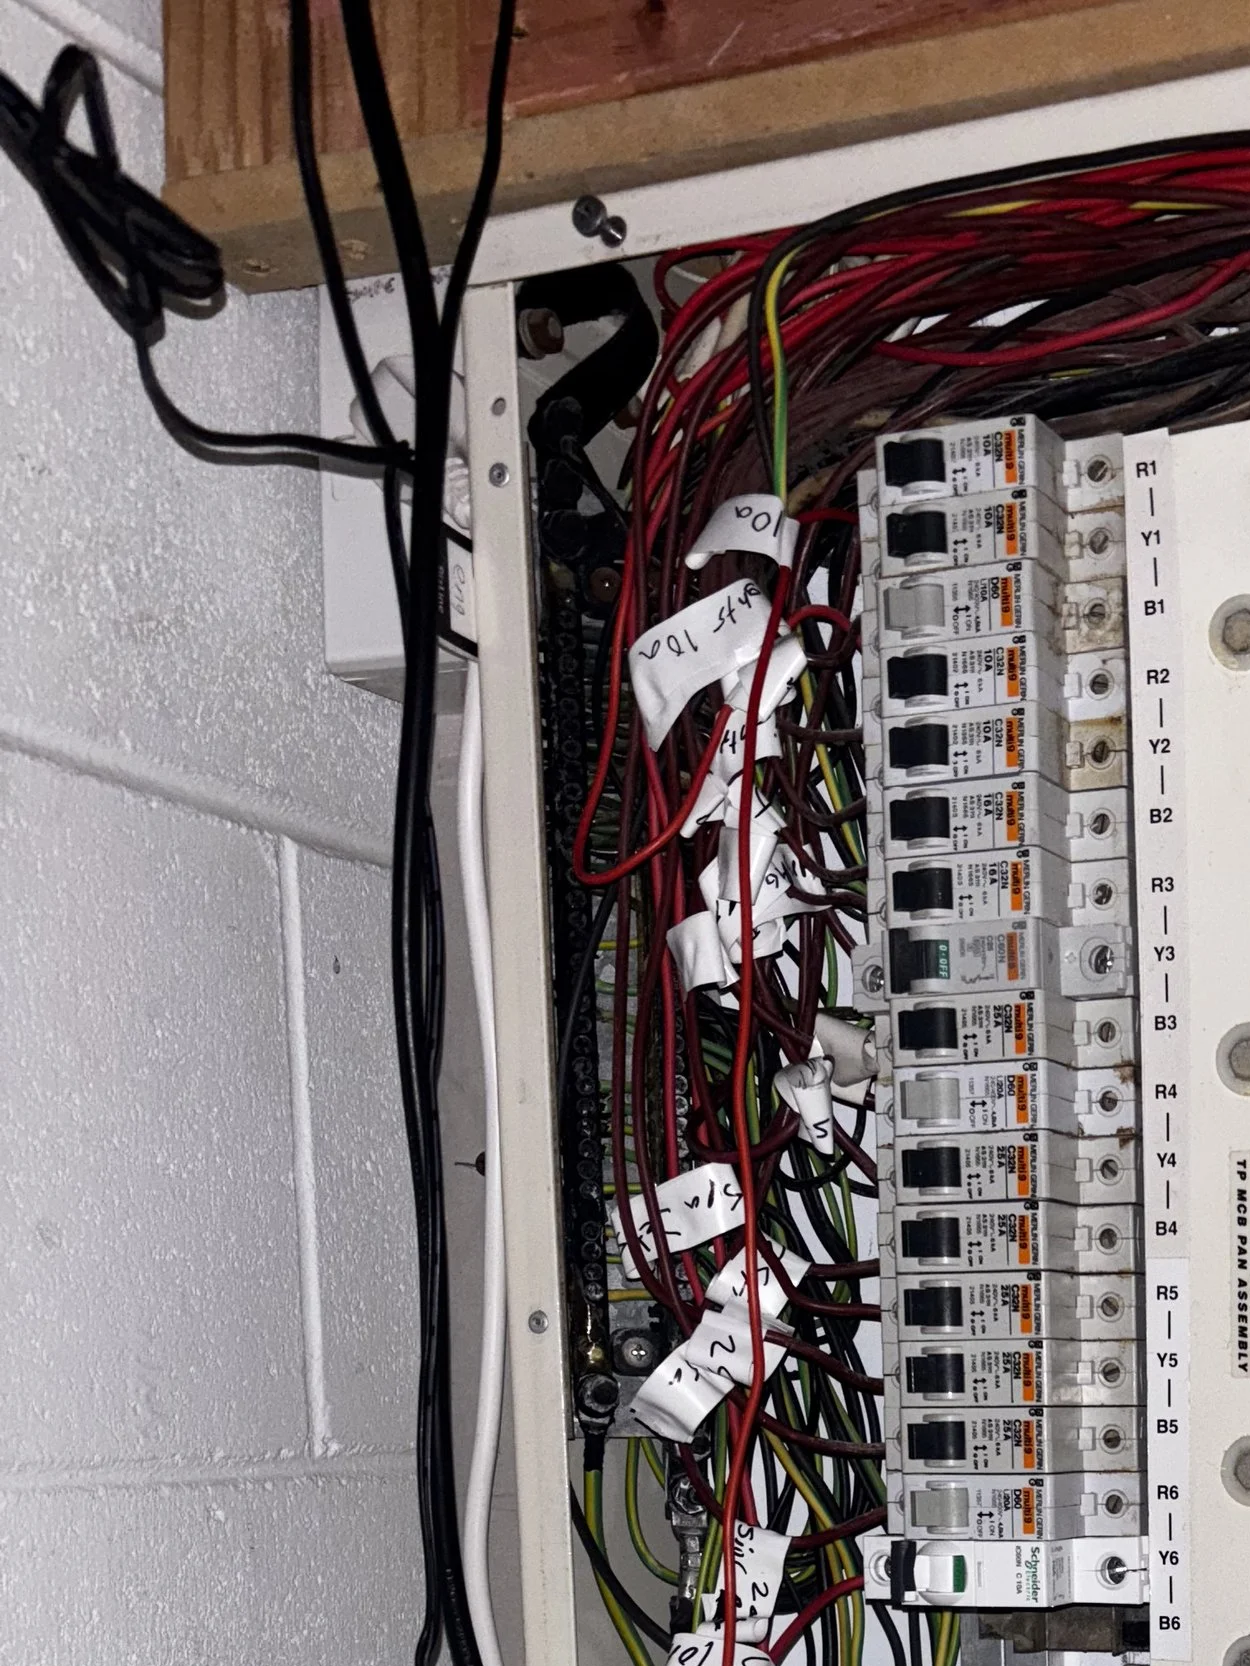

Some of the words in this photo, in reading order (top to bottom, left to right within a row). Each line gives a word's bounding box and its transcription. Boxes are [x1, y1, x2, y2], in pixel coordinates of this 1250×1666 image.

[1135, 460, 1157, 479] R1
[1140, 529, 1161, 547] Y1
[1144, 598, 1165, 616] B1
[1146, 668, 1170, 685] R2
[1148, 738, 1171, 755] Y2
[1149, 807, 1173, 824] B2
[1151, 876, 1175, 893] R3
[1153, 945, 1176, 962] Y3
[1154, 1014, 1177, 1031] B3
[1155, 1083, 1178, 1100] R4
[1156, 1152, 1177, 1168] Y4
[1236, 1160, 1247, 1181] TP
[1236, 1189, 1247, 1226] MCB
[1155, 1220, 1178, 1236] B4
[1237, 1235, 1248, 1270] PAN
[1156, 1285, 1179, 1301] R5
[1238, 1278, 1248, 1373] ASSEMBLY
[1156, 1352, 1178, 1368] Y5
[1156, 1418, 1179, 1434] B5
[1157, 1484, 1179, 1500] R6
[1158, 1550, 1179, 1566] Y6
[1159, 1615, 1181, 1631] B6
